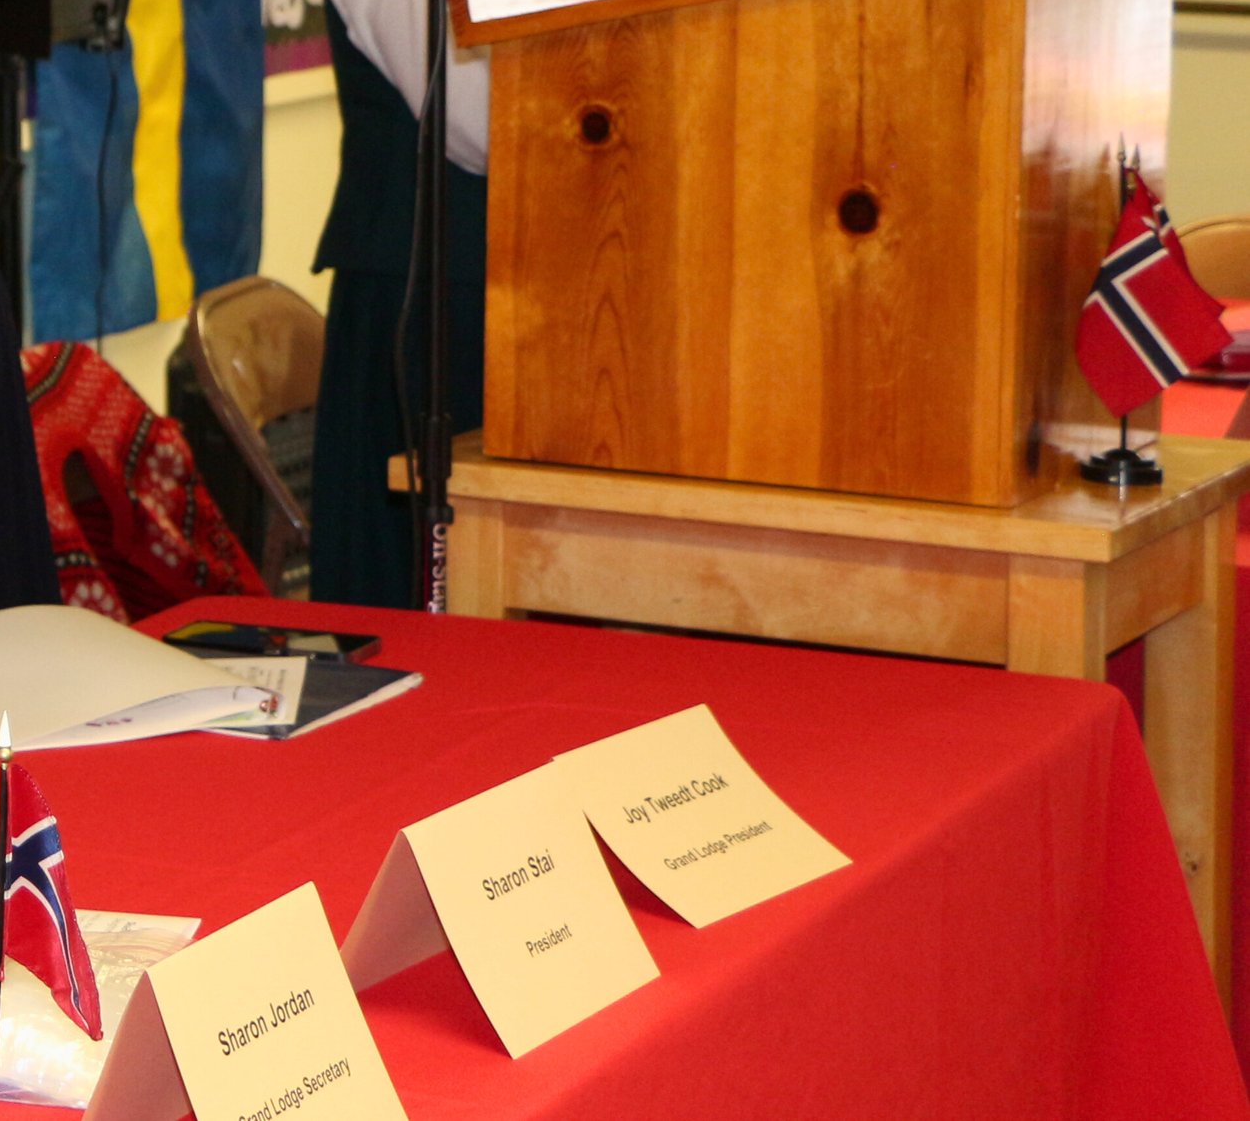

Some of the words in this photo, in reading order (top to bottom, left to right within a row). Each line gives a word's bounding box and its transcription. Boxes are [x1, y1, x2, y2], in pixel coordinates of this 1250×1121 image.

[622, 806, 651, 824] Joy
[644, 784, 697, 814] Tweedt
[691, 772, 730, 797] Cook
[663, 847, 699, 870] Grand
[693, 839, 729, 859] Lodge
[723, 820, 773, 846] President
[482, 867, 530, 901] Sharon
[527, 848, 555, 878] Stai
[525, 923, 573, 958] President
[218, 1015, 269, 1056] Sharon
[269, 989, 315, 1028] Jordan
[238, 1101, 273, 1121] and
[270, 1086, 305, 1116] Lodge
[302, 1057, 352, 1095] Secretary
